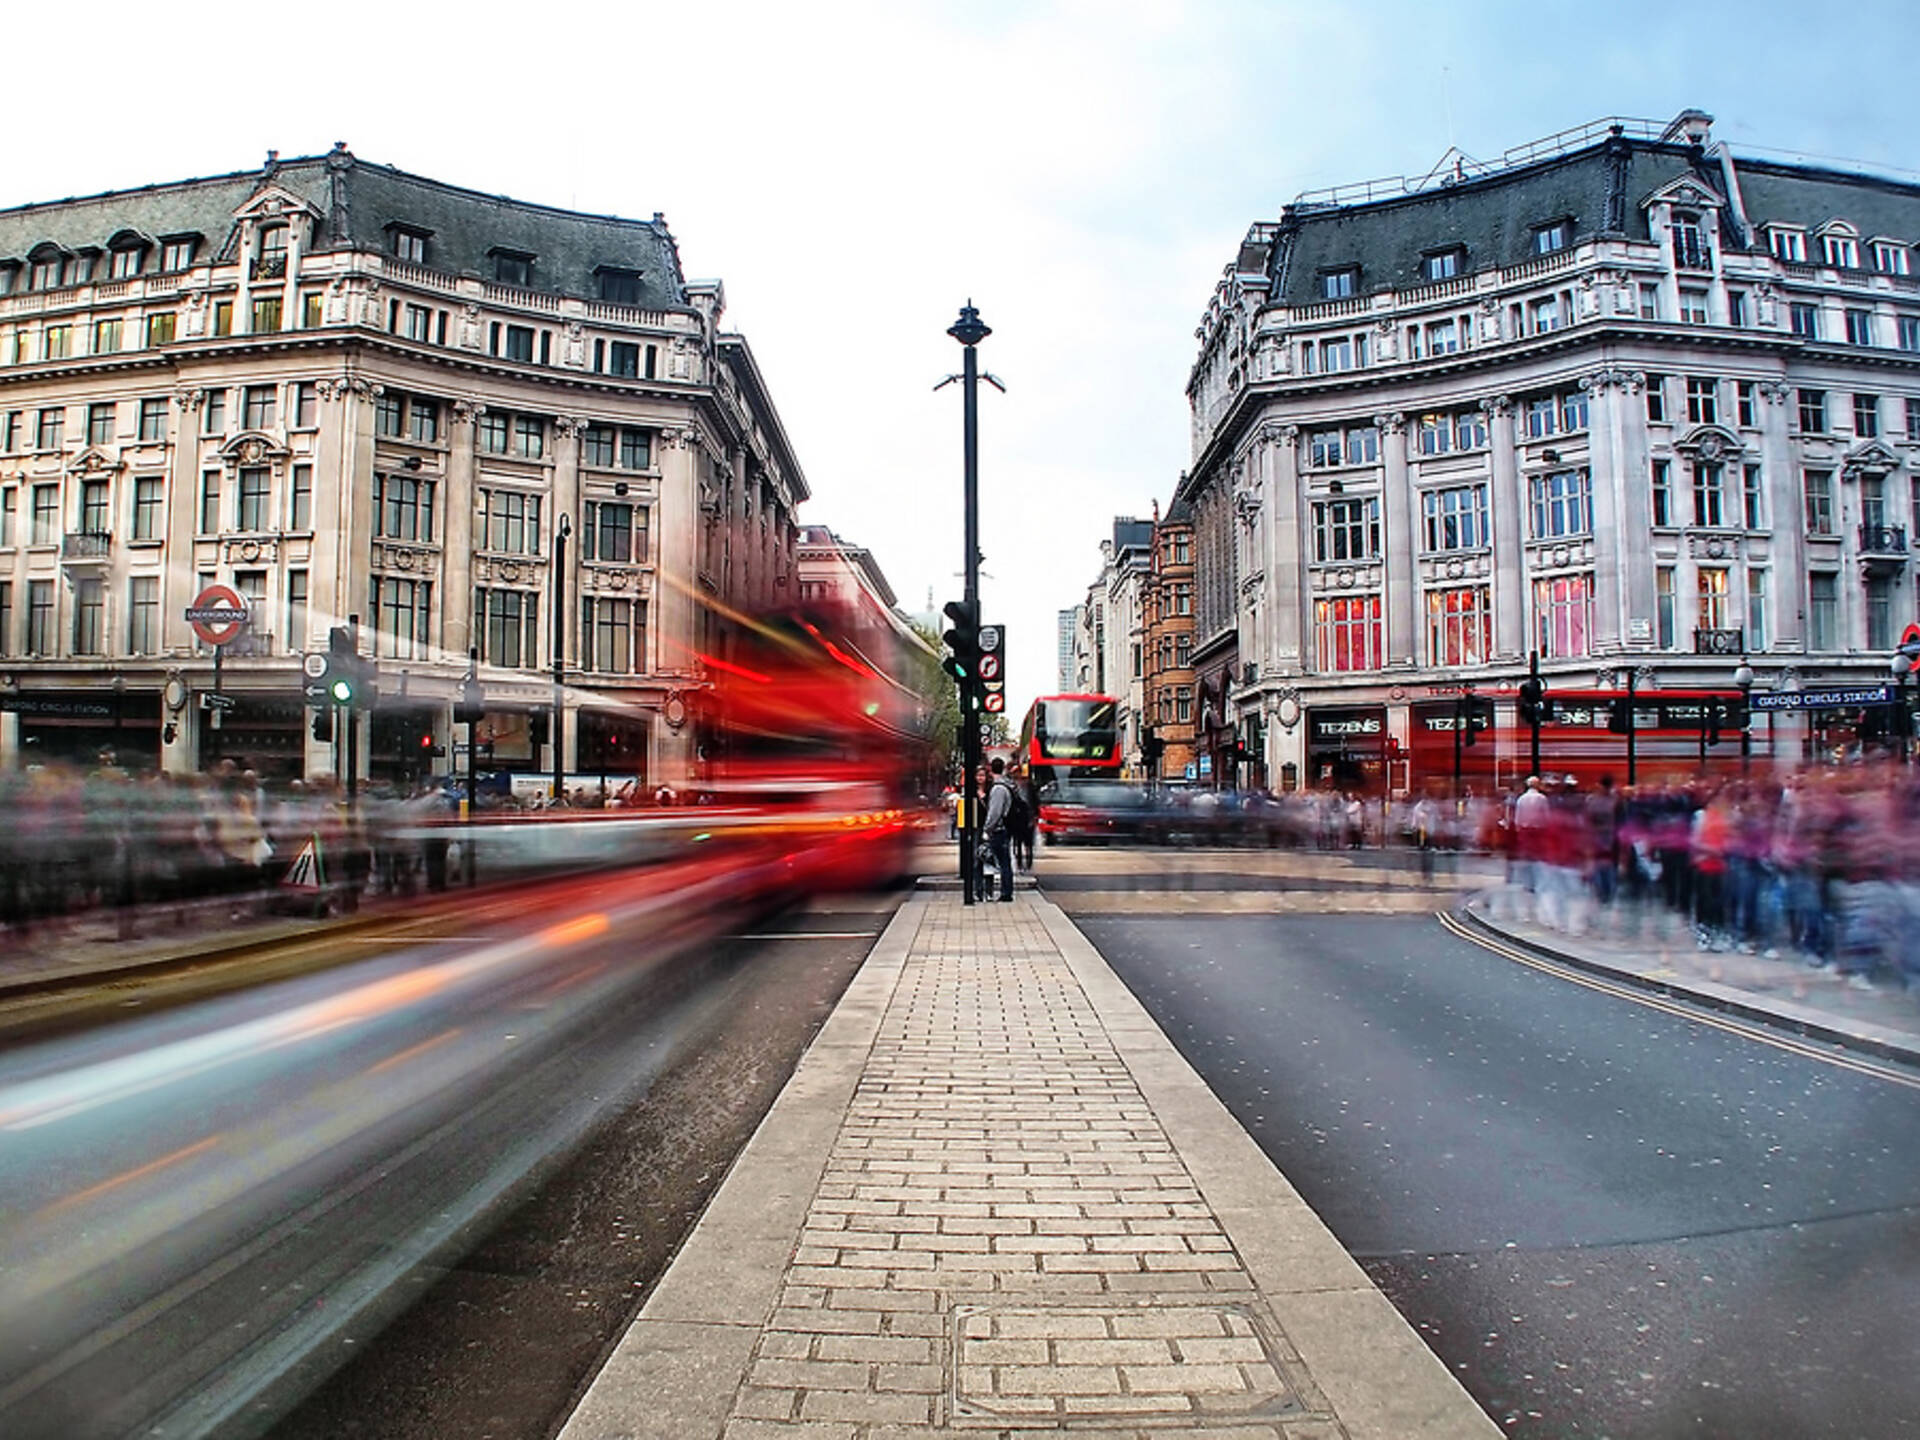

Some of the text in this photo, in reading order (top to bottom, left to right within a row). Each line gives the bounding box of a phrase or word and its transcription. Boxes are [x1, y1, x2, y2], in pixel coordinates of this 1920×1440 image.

[187, 611, 246, 619] UNDERGROUND
[1758, 688, 1887, 706] OXFORD CIRCUS STATION
[40, 703, 71, 712] CIRCUS
[74, 704, 109, 714] STATION
[1318, 719, 1381, 734] TEZENIS
